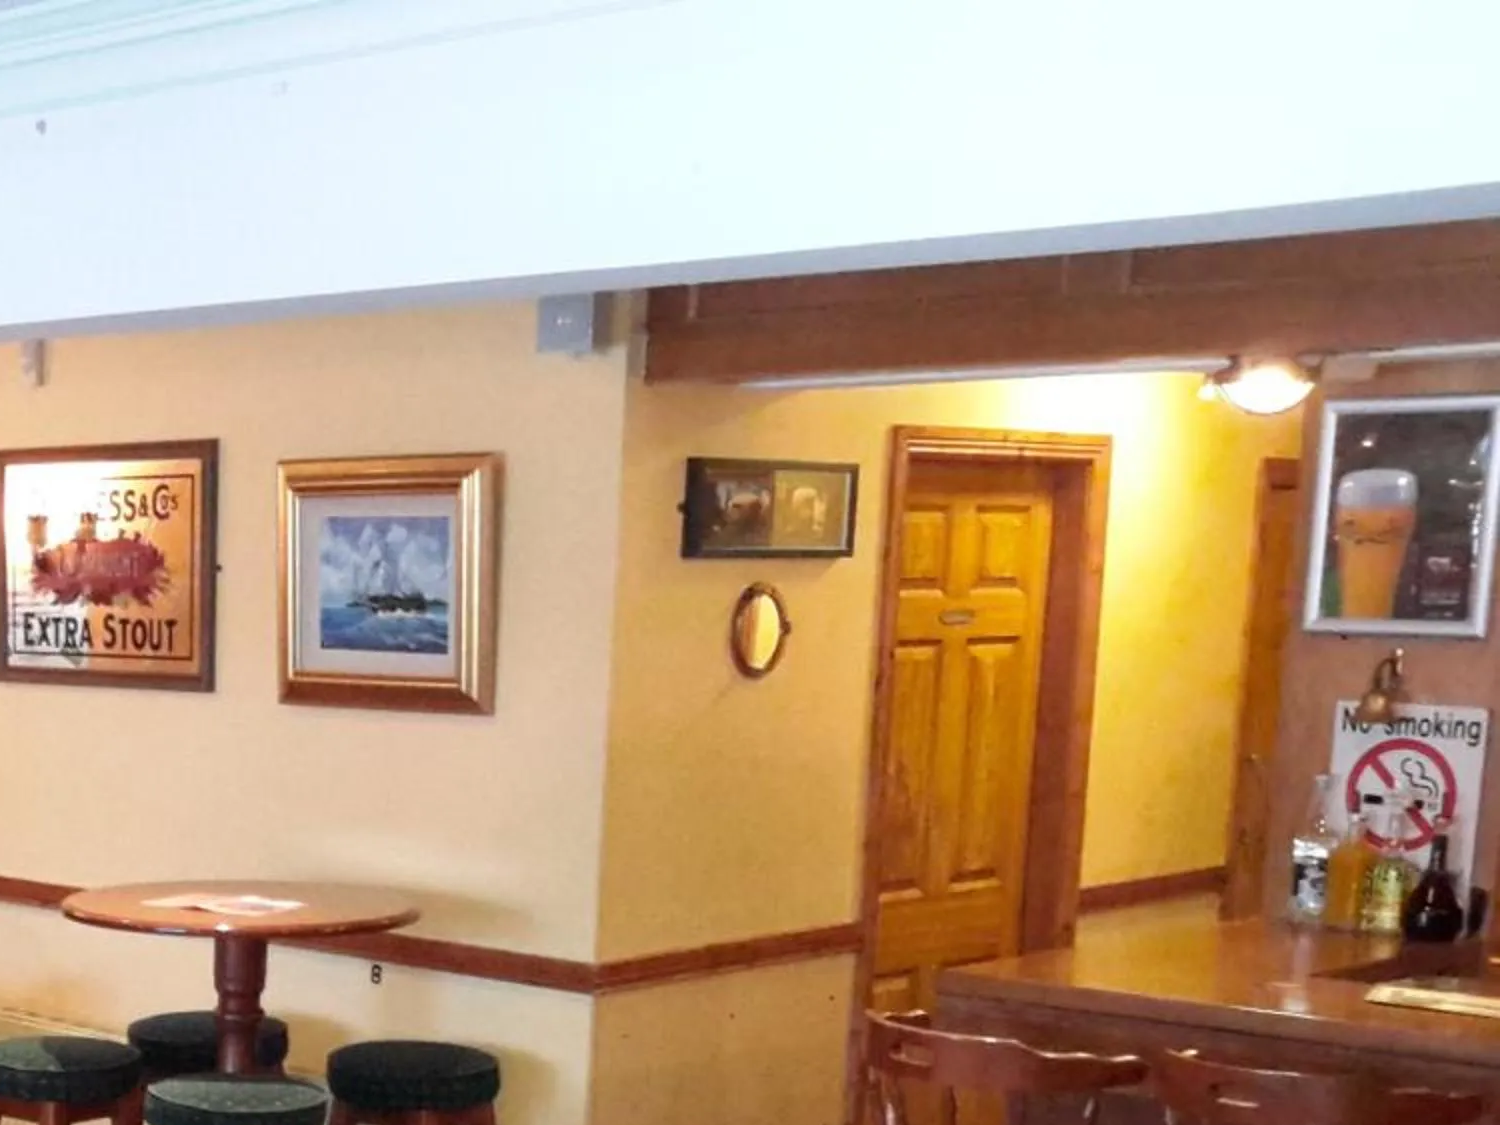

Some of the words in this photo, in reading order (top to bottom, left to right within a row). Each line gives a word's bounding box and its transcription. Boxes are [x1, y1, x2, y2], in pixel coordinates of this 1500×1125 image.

[23, 613, 93, 648] EXTRA
[103, 614, 178, 652] STOUT
[1384, 711, 1482, 747] smoking
